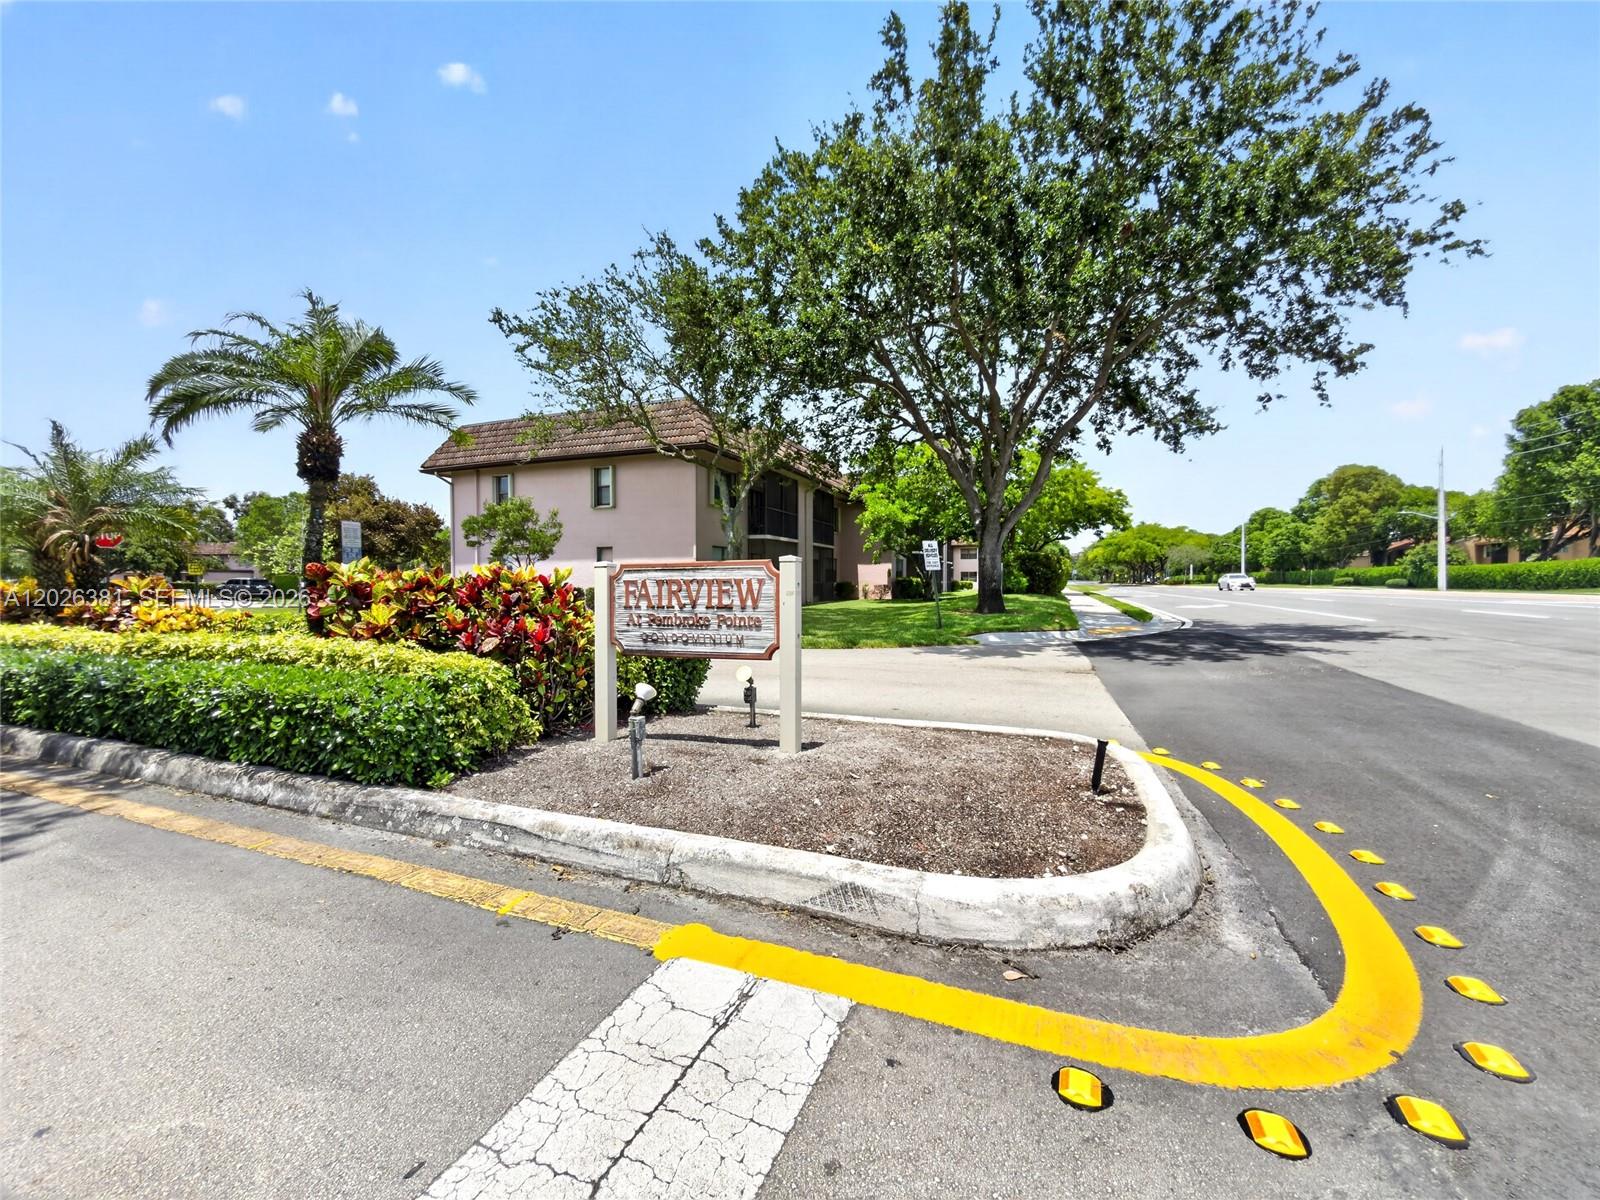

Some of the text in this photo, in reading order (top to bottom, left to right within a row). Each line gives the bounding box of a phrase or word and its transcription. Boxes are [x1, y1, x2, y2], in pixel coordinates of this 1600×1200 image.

[623, 578, 765, 609] FAIRVIEW
[626, 613, 762, 629] At Pembroke Pointe
